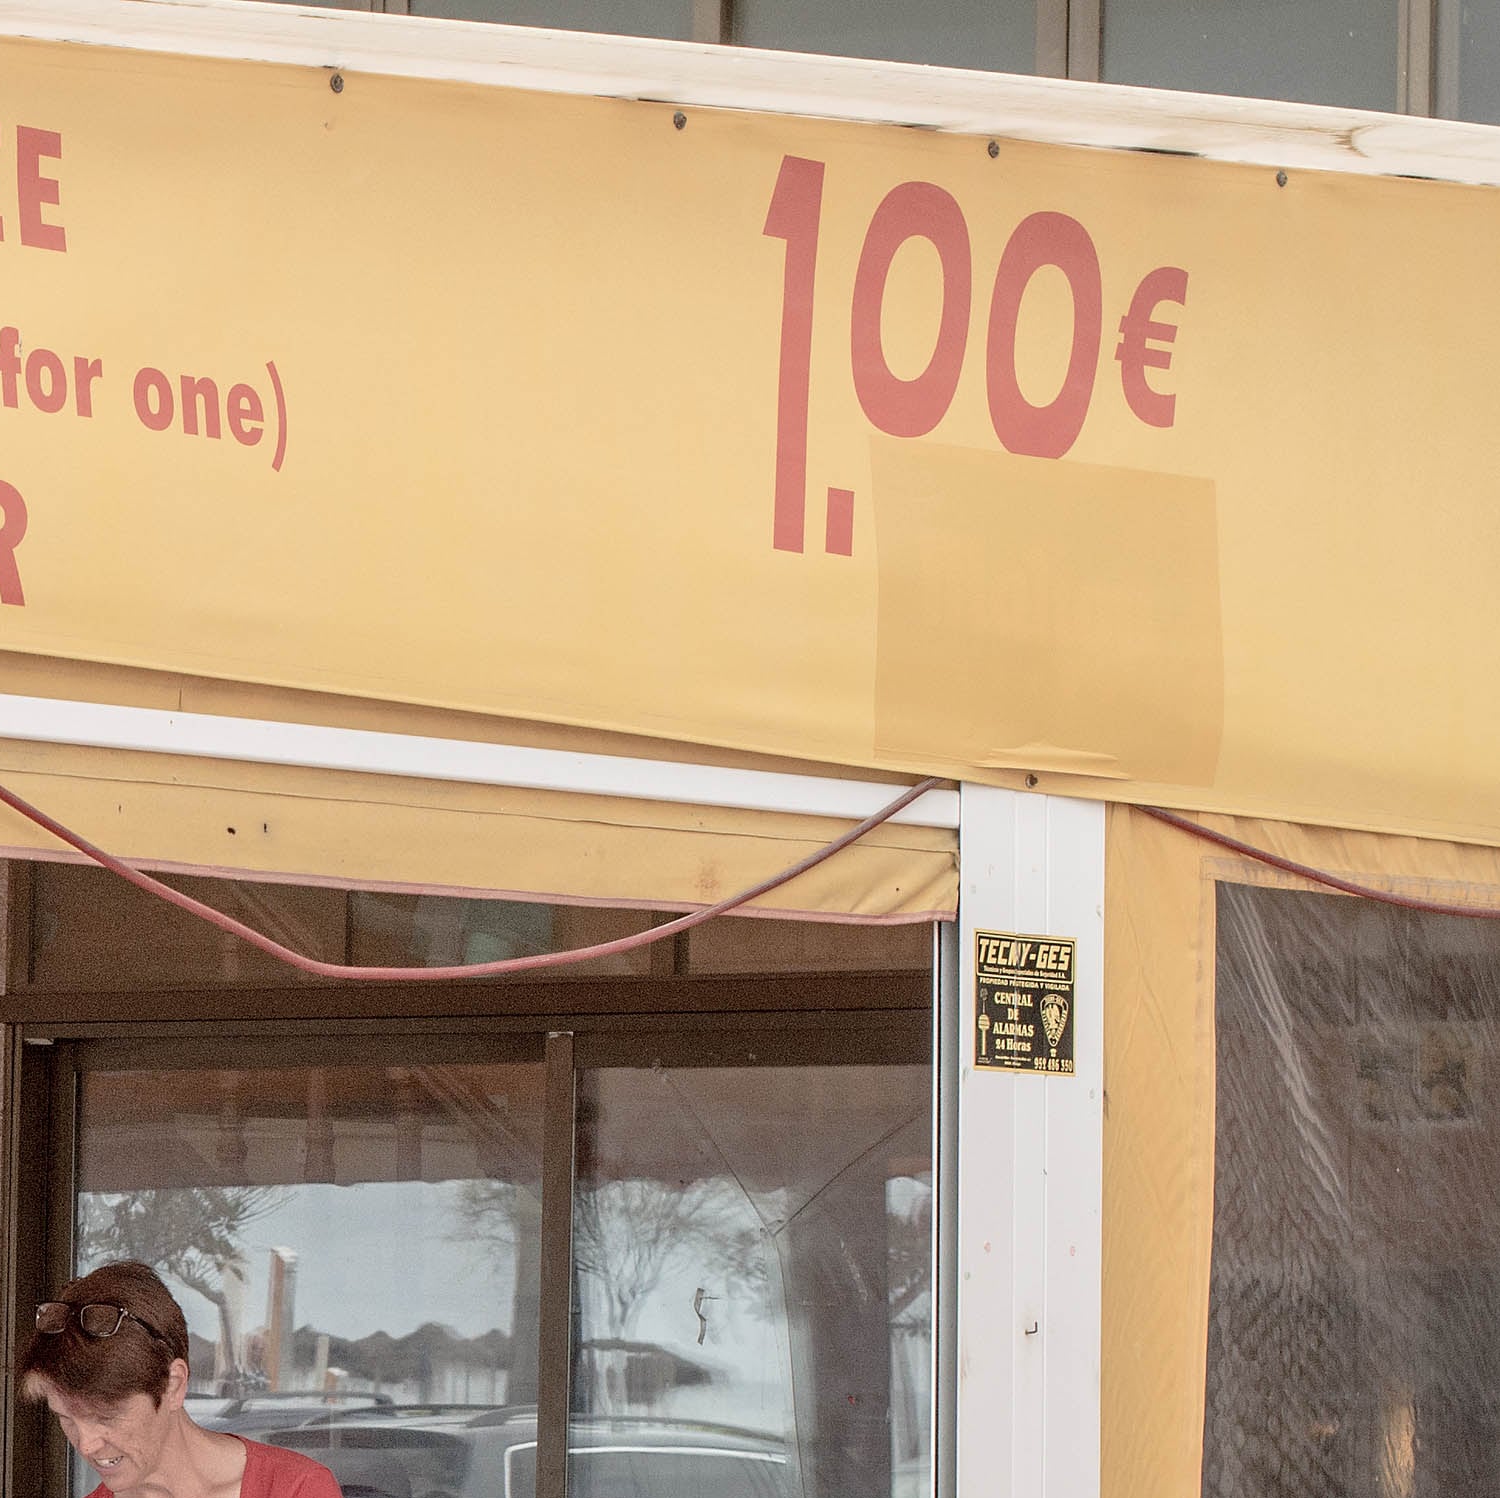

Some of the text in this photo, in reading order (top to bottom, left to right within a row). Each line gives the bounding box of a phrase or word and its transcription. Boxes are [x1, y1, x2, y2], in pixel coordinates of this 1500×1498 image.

[133, 360, 286, 472] one)
[979, 938, 1071, 971] TECNY-GES
[995, 991, 1033, 1007] CENTRAL
[1007, 1008, 1019, 1021] DE
[993, 1022, 1034, 1038] ALARMAS
[1007, 1038, 1032, 1052] Horas
